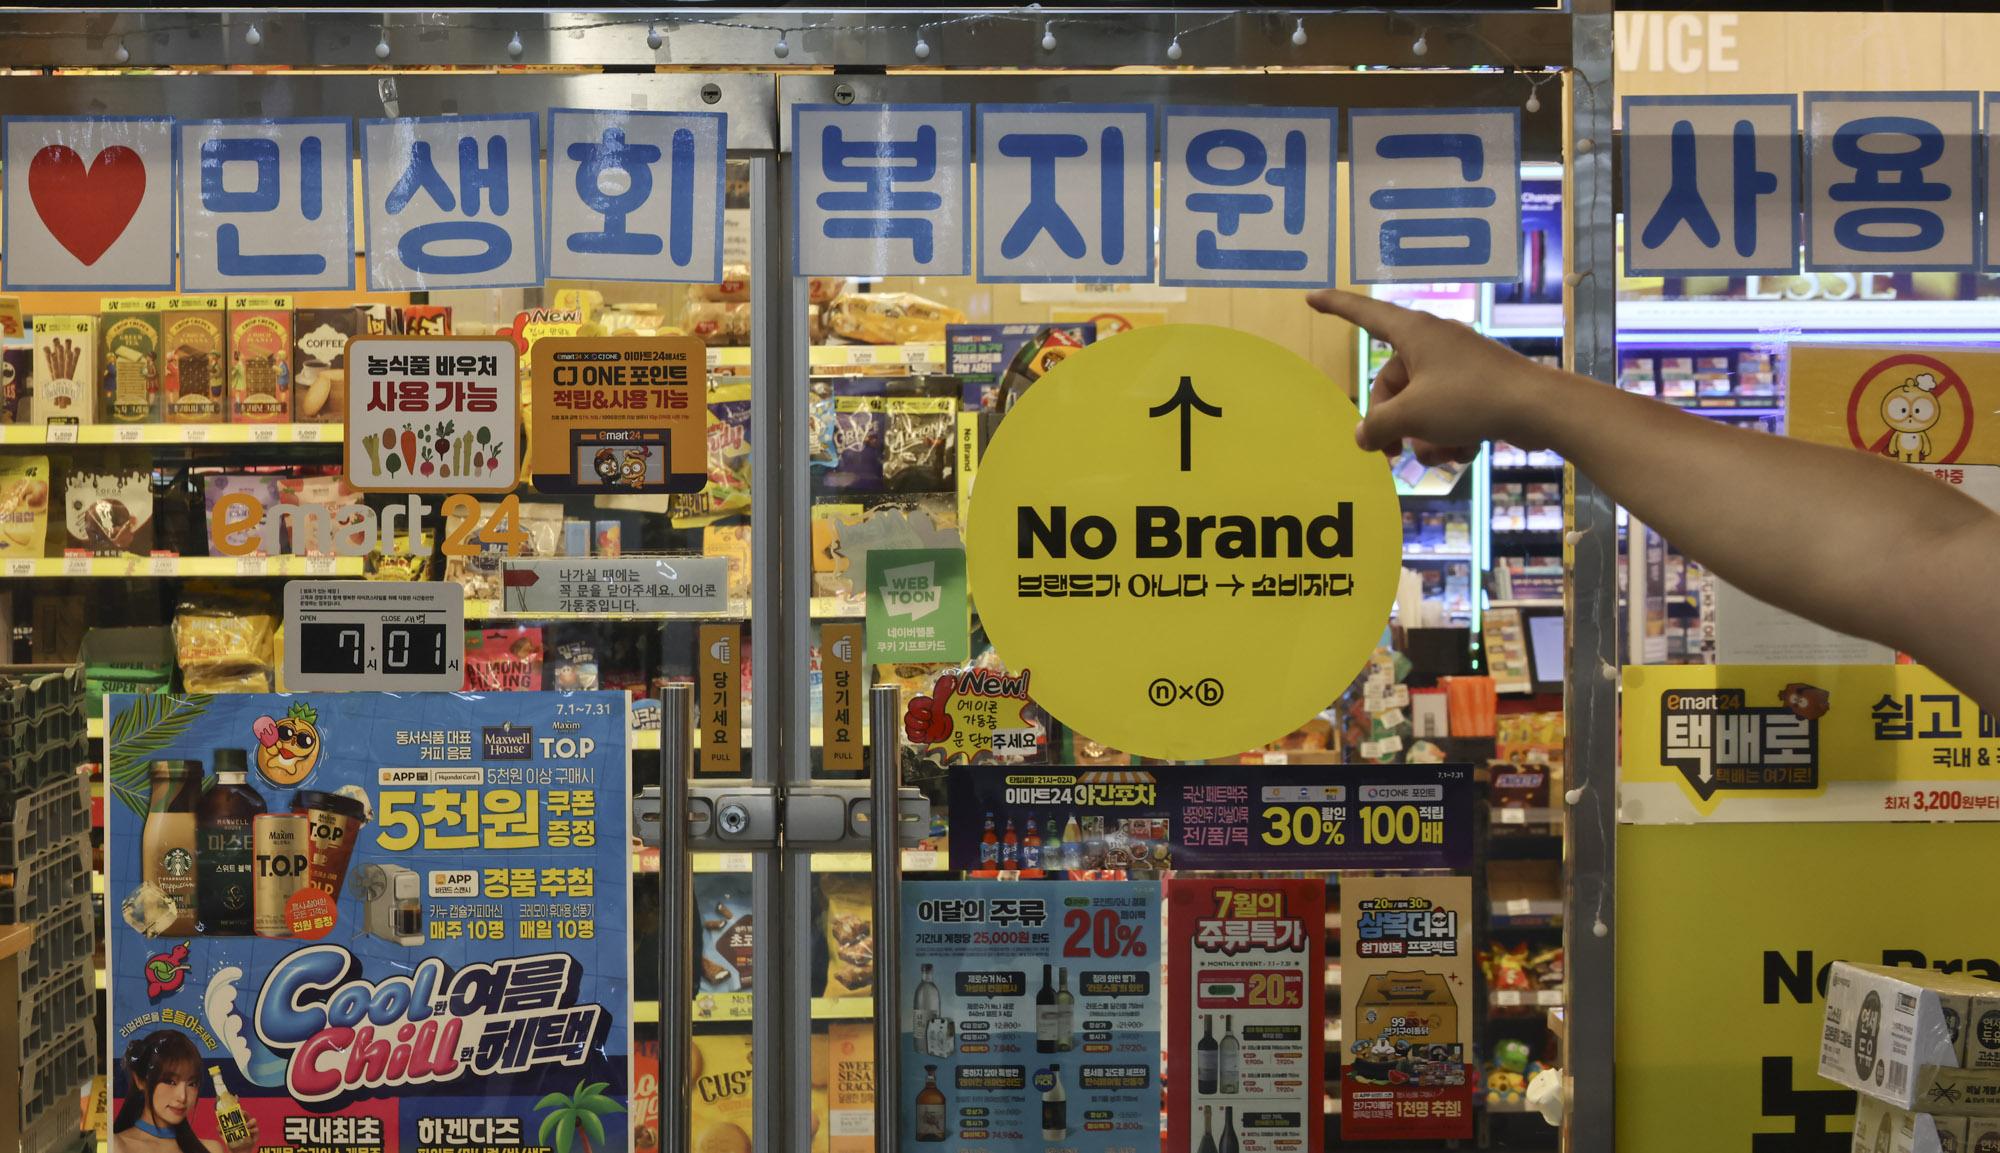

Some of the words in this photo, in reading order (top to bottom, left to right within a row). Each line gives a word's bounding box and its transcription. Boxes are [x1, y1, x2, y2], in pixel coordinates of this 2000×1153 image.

[1641, 116, 1952, 258] 사용
[306, 338, 345, 349] COFFEE
[367, 356, 430, 377] 농식품
[435, 356, 498, 377] 바우처
[553, 366, 578, 387] CJ
[583, 366, 627, 387] ONE
[630, 366, 689, 387] 포인트
[367, 381, 430, 413] 사용
[435, 381, 498, 413] 가능
[650, 389, 689, 410] 가능
[963, 428, 971, 443] No
[963, 444, 971, 472] Brand
[1017, 505, 1117, 560] No
[1135, 501, 1354, 560] Brand
[559, 568, 598, 582] 나가실
[602, 568, 640, 582] 때에는
[892, 576, 929, 591] WEB
[559, 584, 573, 597] 꼭
[577, 584, 602, 597] 문을
[679, 584, 717, 597] 에어콘
[1018, 574, 1120, 598] 브랜드가
[1128, 574, 1208, 598] 아니다
[1251, 573, 1354, 597] 소비자다
[559, 600, 640, 612] 가동중입니다.
[888, 590, 935, 606] TOON
[339, 630, 361, 666] 7
[367, 659, 377, 671] 시
[877, 641, 897, 653] 쿠키
[898, 640, 946, 653] 기프트카드
[449, 659, 459, 671] 시
[102, 681, 137, 693] SUPER
[960, 669, 1030, 697] New!
[556, 703, 611, 715] 7.1~7.31
[712, 671, 728, 745] 당기세요
[835, 670, 850, 744] 당기세요
[1667, 693, 1741, 711] emart24
[552, 720, 581, 730] Maxim
[963, 714, 998, 729] 가동중
[1871, 693, 1962, 741] 쉽고
[396, 730, 445, 745] 동서식품
[447, 730, 472, 745] 대표
[484, 733, 530, 745] Maxwell
[953, 731, 965, 747] 문
[421, 746, 445, 760] 커피
[447, 746, 472, 760] 음료
[490, 744, 525, 755] House
[539, 737, 595, 759] T.O.P
[834, 752, 853, 760] PULL
[711, 753, 731, 761] PULL
[1932, 747, 1972, 768] 국내
[1977, 749, 1991, 767] &
[392, 772, 415, 782] APP
[487, 768, 523, 784] 5천원
[526, 768, 553, 784] 이상
[555, 767, 594, 784] 구매시
[1716, 768, 1760, 784] 택배는
[1763, 767, 1812, 784] 여기로!
[1005, 788, 1072, 805] 이마트24
[1074, 784, 1157, 806] 야간포차
[1183, 786, 1205, 803] 국산
[1206, 785, 1249, 803] 페트맥주
[1411, 788, 1436, 798] 포인트
[1884, 796, 1910, 810] 최저
[1913, 791, 2000, 811] 3,200원부터
[376, 788, 540, 851] 5천원
[547, 790, 596, 817] 쿠폰
[1321, 806, 1346, 821] 할인
[1420, 806, 1444, 820] 적립
[269, 830, 295, 841] Maxim
[547, 820, 596, 848] 증정
[256, 855, 308, 877] T.O.P
[447, 874, 472, 884] APP
[483, 868, 537, 899] 경품
[540, 867, 595, 898] 추첨
[430, 904, 448, 918] 카누
[449, 904, 503, 918] 캡슐커피머신
[1215, 890, 1282, 918] 7월의
[917, 899, 985, 923] 이달의
[989, 898, 1048, 928] 주류
[292, 919, 312, 934] 전원
[313, 916, 334, 931] 증정
[429, 921, 463, 940] 매주
[467, 921, 505, 940] 10명
[519, 921, 553, 940] 매일
[557, 920, 595, 940] 10명
[973, 932, 1030, 945] 25,000원
[1031, 933, 1050, 943] 한도
[1198, 920, 1302, 950] 주류특가
[1361, 942, 1403, 953] 원기회복
[1407, 940, 1455, 954] 프로젝트
[449, 958, 567, 1017] 여름
[475, 1009, 597, 1070] 혜택
[1396, 1101, 1429, 1118] 1천명
[1431, 1101, 1462, 1118] 추첨!
[284, 1117, 382, 1146] 국내최초
[418, 1117, 521, 1144] 하겐다즈
